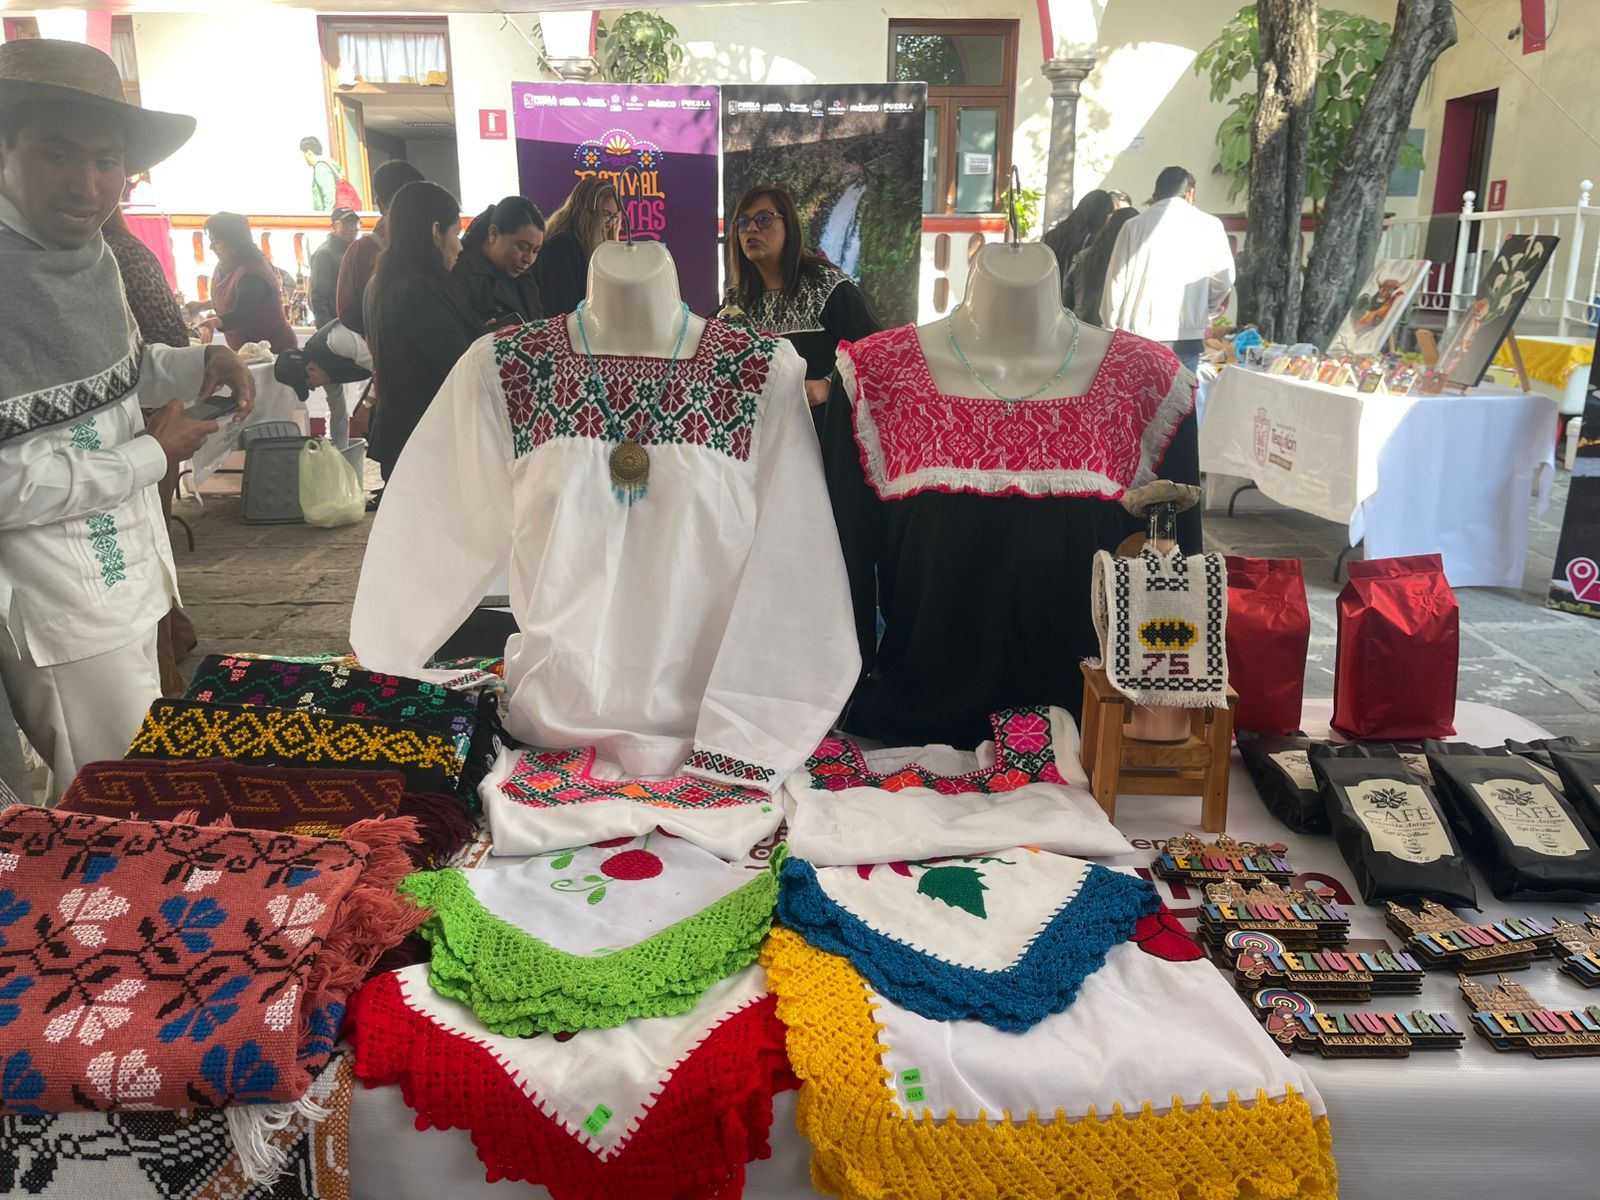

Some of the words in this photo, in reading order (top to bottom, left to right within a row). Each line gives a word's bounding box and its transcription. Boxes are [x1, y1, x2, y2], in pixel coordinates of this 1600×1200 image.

[574, 170, 665, 199] TIVAL
[1142, 653, 1190, 675] 75
[1363, 805, 1432, 823] CAFÉ
[1494, 804, 1561, 819] CAFÉ
